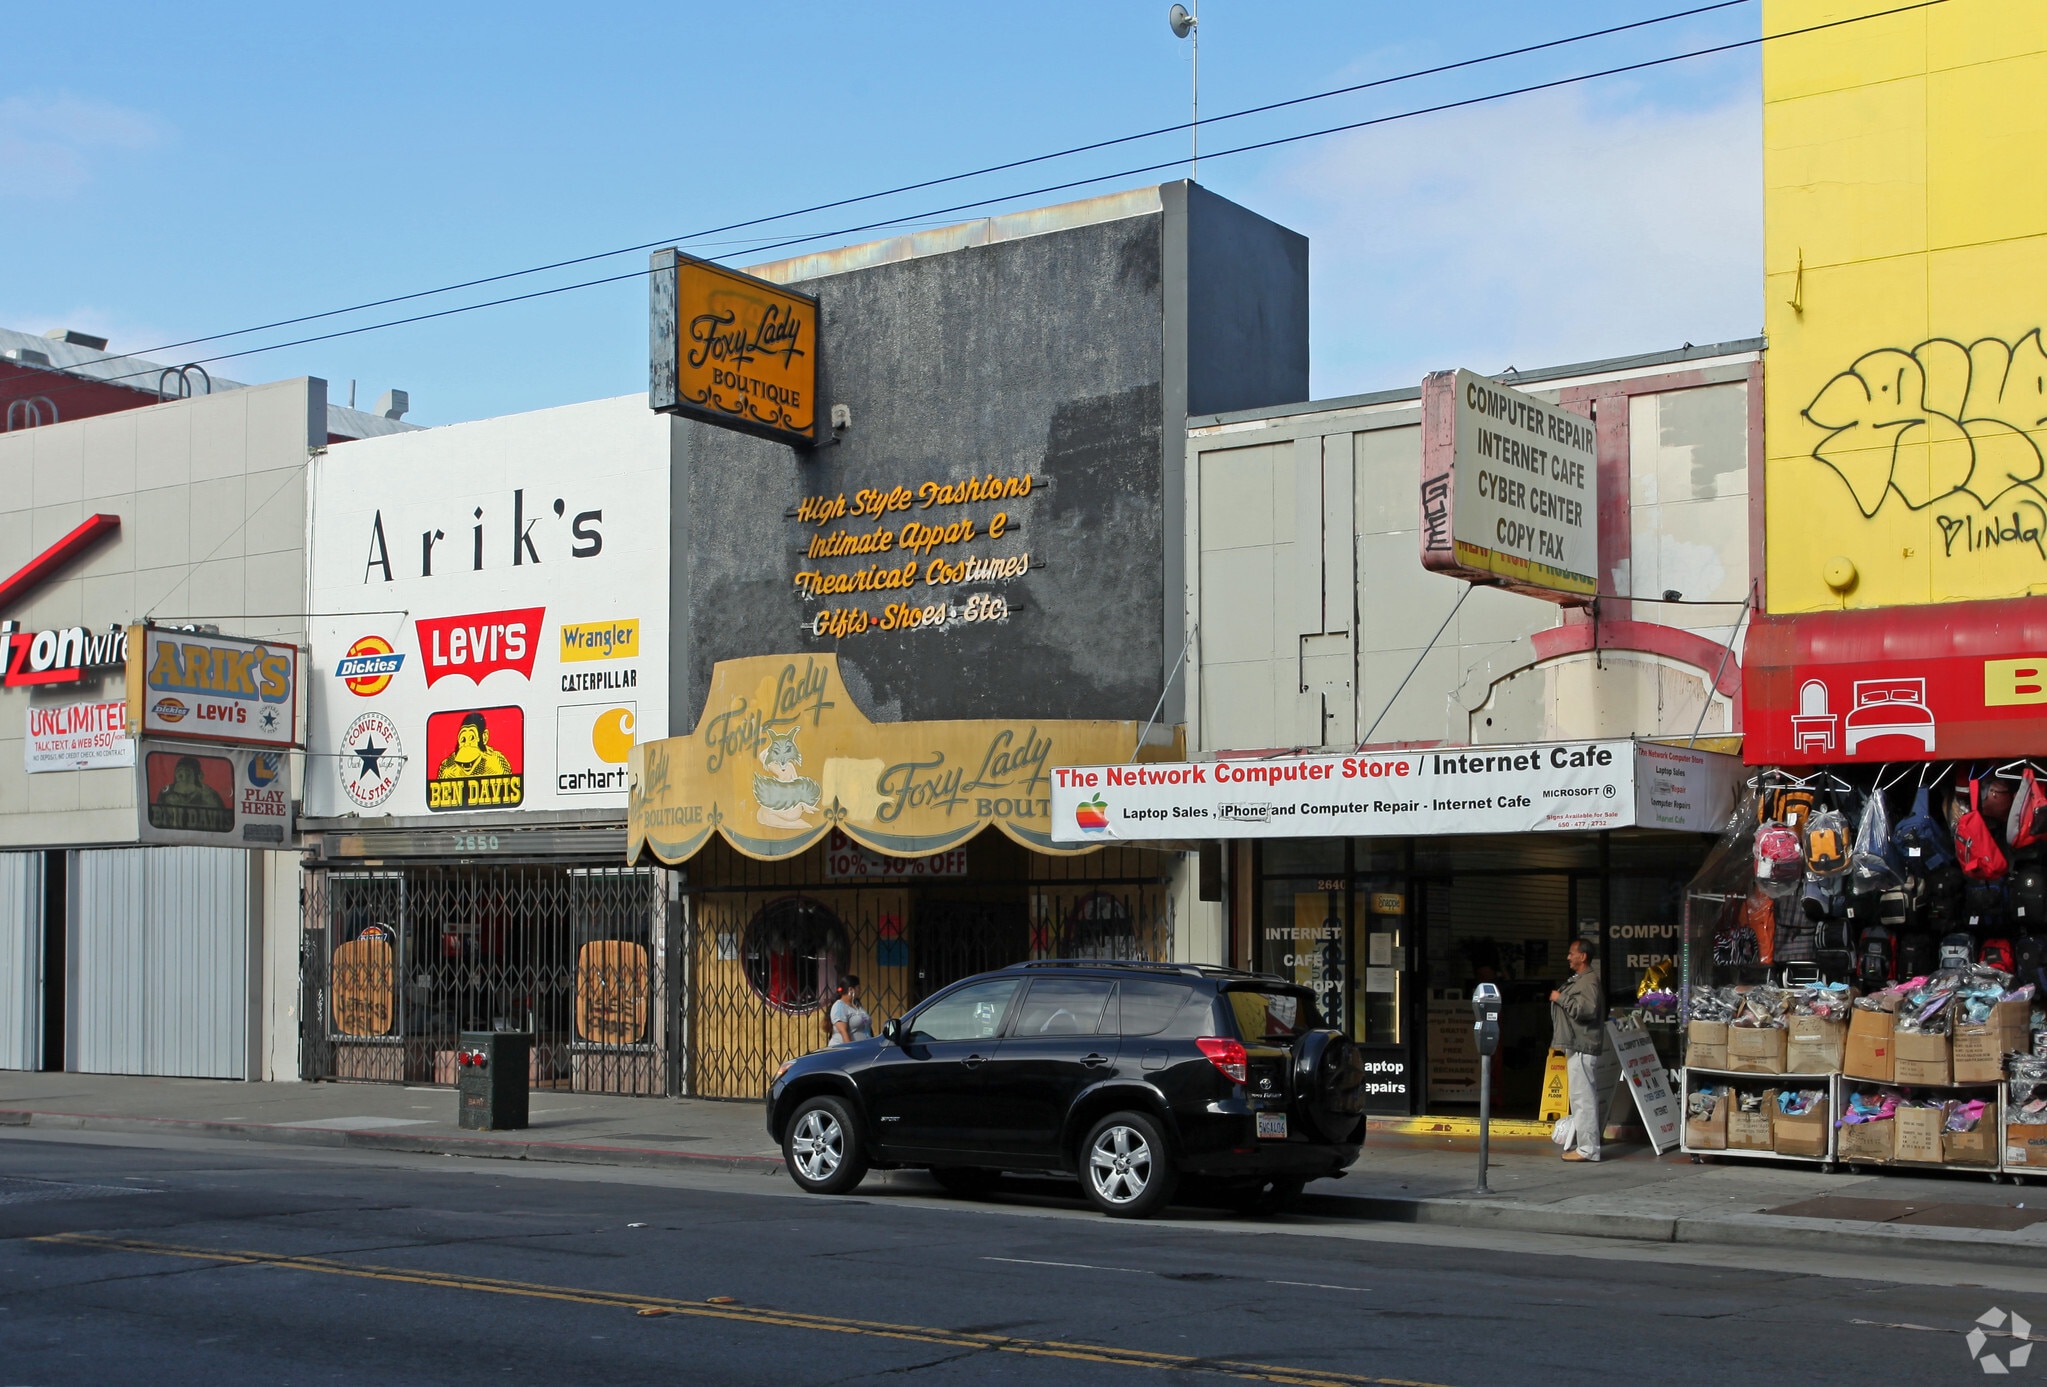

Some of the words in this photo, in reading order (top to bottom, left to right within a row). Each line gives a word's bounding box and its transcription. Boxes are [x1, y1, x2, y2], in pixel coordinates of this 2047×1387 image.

[688, 309, 754, 371] Foxy
[746, 303, 805, 370] Lady
[712, 367, 800, 408] BOUTIQUE
[1466, 382, 1544, 436] COMPUTER
[1548, 414, 1594, 455] REPAIR
[1477, 427, 1547, 476] INTERNET
[1551, 454, 1585, 490] CAFE
[797, 492, 846, 527] High
[849, 486, 913, 521] Style
[918, 473, 1032, 509] Fashions
[1478, 470, 1526, 510] CYBER
[1530, 487, 1582, 527] CENTER
[807, 526, 893, 559] Intimate
[1496, 517, 1535, 552] COPY
[1539, 529, 1564, 562] FAX
[925, 553, 1030, 586] Costumes
[812, 607, 868, 639] Gifts
[880, 601, 946, 631] Shoes
[563, 624, 633, 656] Wrangler
[149, 640, 291, 703] ARIK'S
[341, 659, 398, 675] Dickies
[561, 669, 637, 692] CATERPILLAR
[705, 697, 767, 773] Foxy
[762, 656, 834, 730] Lady
[78, 738, 92, 749] WEB
[349, 719, 394, 746] CONVERSE
[1055, 768, 1099, 787] The
[1107, 766, 1206, 786] Network
[1214, 762, 1334, 786] Computer
[1341, 758, 1410, 779] Store
[1433, 749, 1541, 775] Internet
[1550, 746, 1612, 769] Cafe
[1648, 750, 1668, 760] Network
[1668, 752, 1691, 764] Computer
[558, 767, 628, 790] carhart
[876, 750, 968, 822] Foxy
[962, 726, 1053, 795] Lady
[1656, 766, 1672, 776] Laptop
[1673, 768, 1686, 776] Sales
[245, 788, 284, 804] PLAY
[350, 780, 367, 800] ALL
[369, 776, 393, 800] STAR
[429, 780, 463, 808] BEN
[467, 776, 522, 805] DAVIS
[1542, 787, 1600, 798] MICROSOFT
[241, 801, 286, 816] HERE
[644, 805, 703, 828] BOUTIQUE
[1123, 806, 1168, 821] Laptop
[1172, 805, 1209, 819] Sales
[1220, 804, 1267, 818] iPhone
[1271, 803, 1296, 816] and
[1300, 800, 1369, 818] Computer
[1373, 799, 1420, 815] Repair
[1433, 796, 1492, 811] Internet
[1497, 794, 1532, 809] Cafe
[1565, 812, 1592, 820] Available
[454, 836, 499, 851] 2650
[829, 854, 868, 875] 10%
[929, 851, 965, 873] OFF
[1265, 927, 1342, 941] INTERNET
[1609, 925, 1682, 939] COMPUT
[1627, 954, 1680, 968] REPAI
[1364, 1062, 1404, 1074] aptop
[1366, 1082, 1406, 1095] epairs
